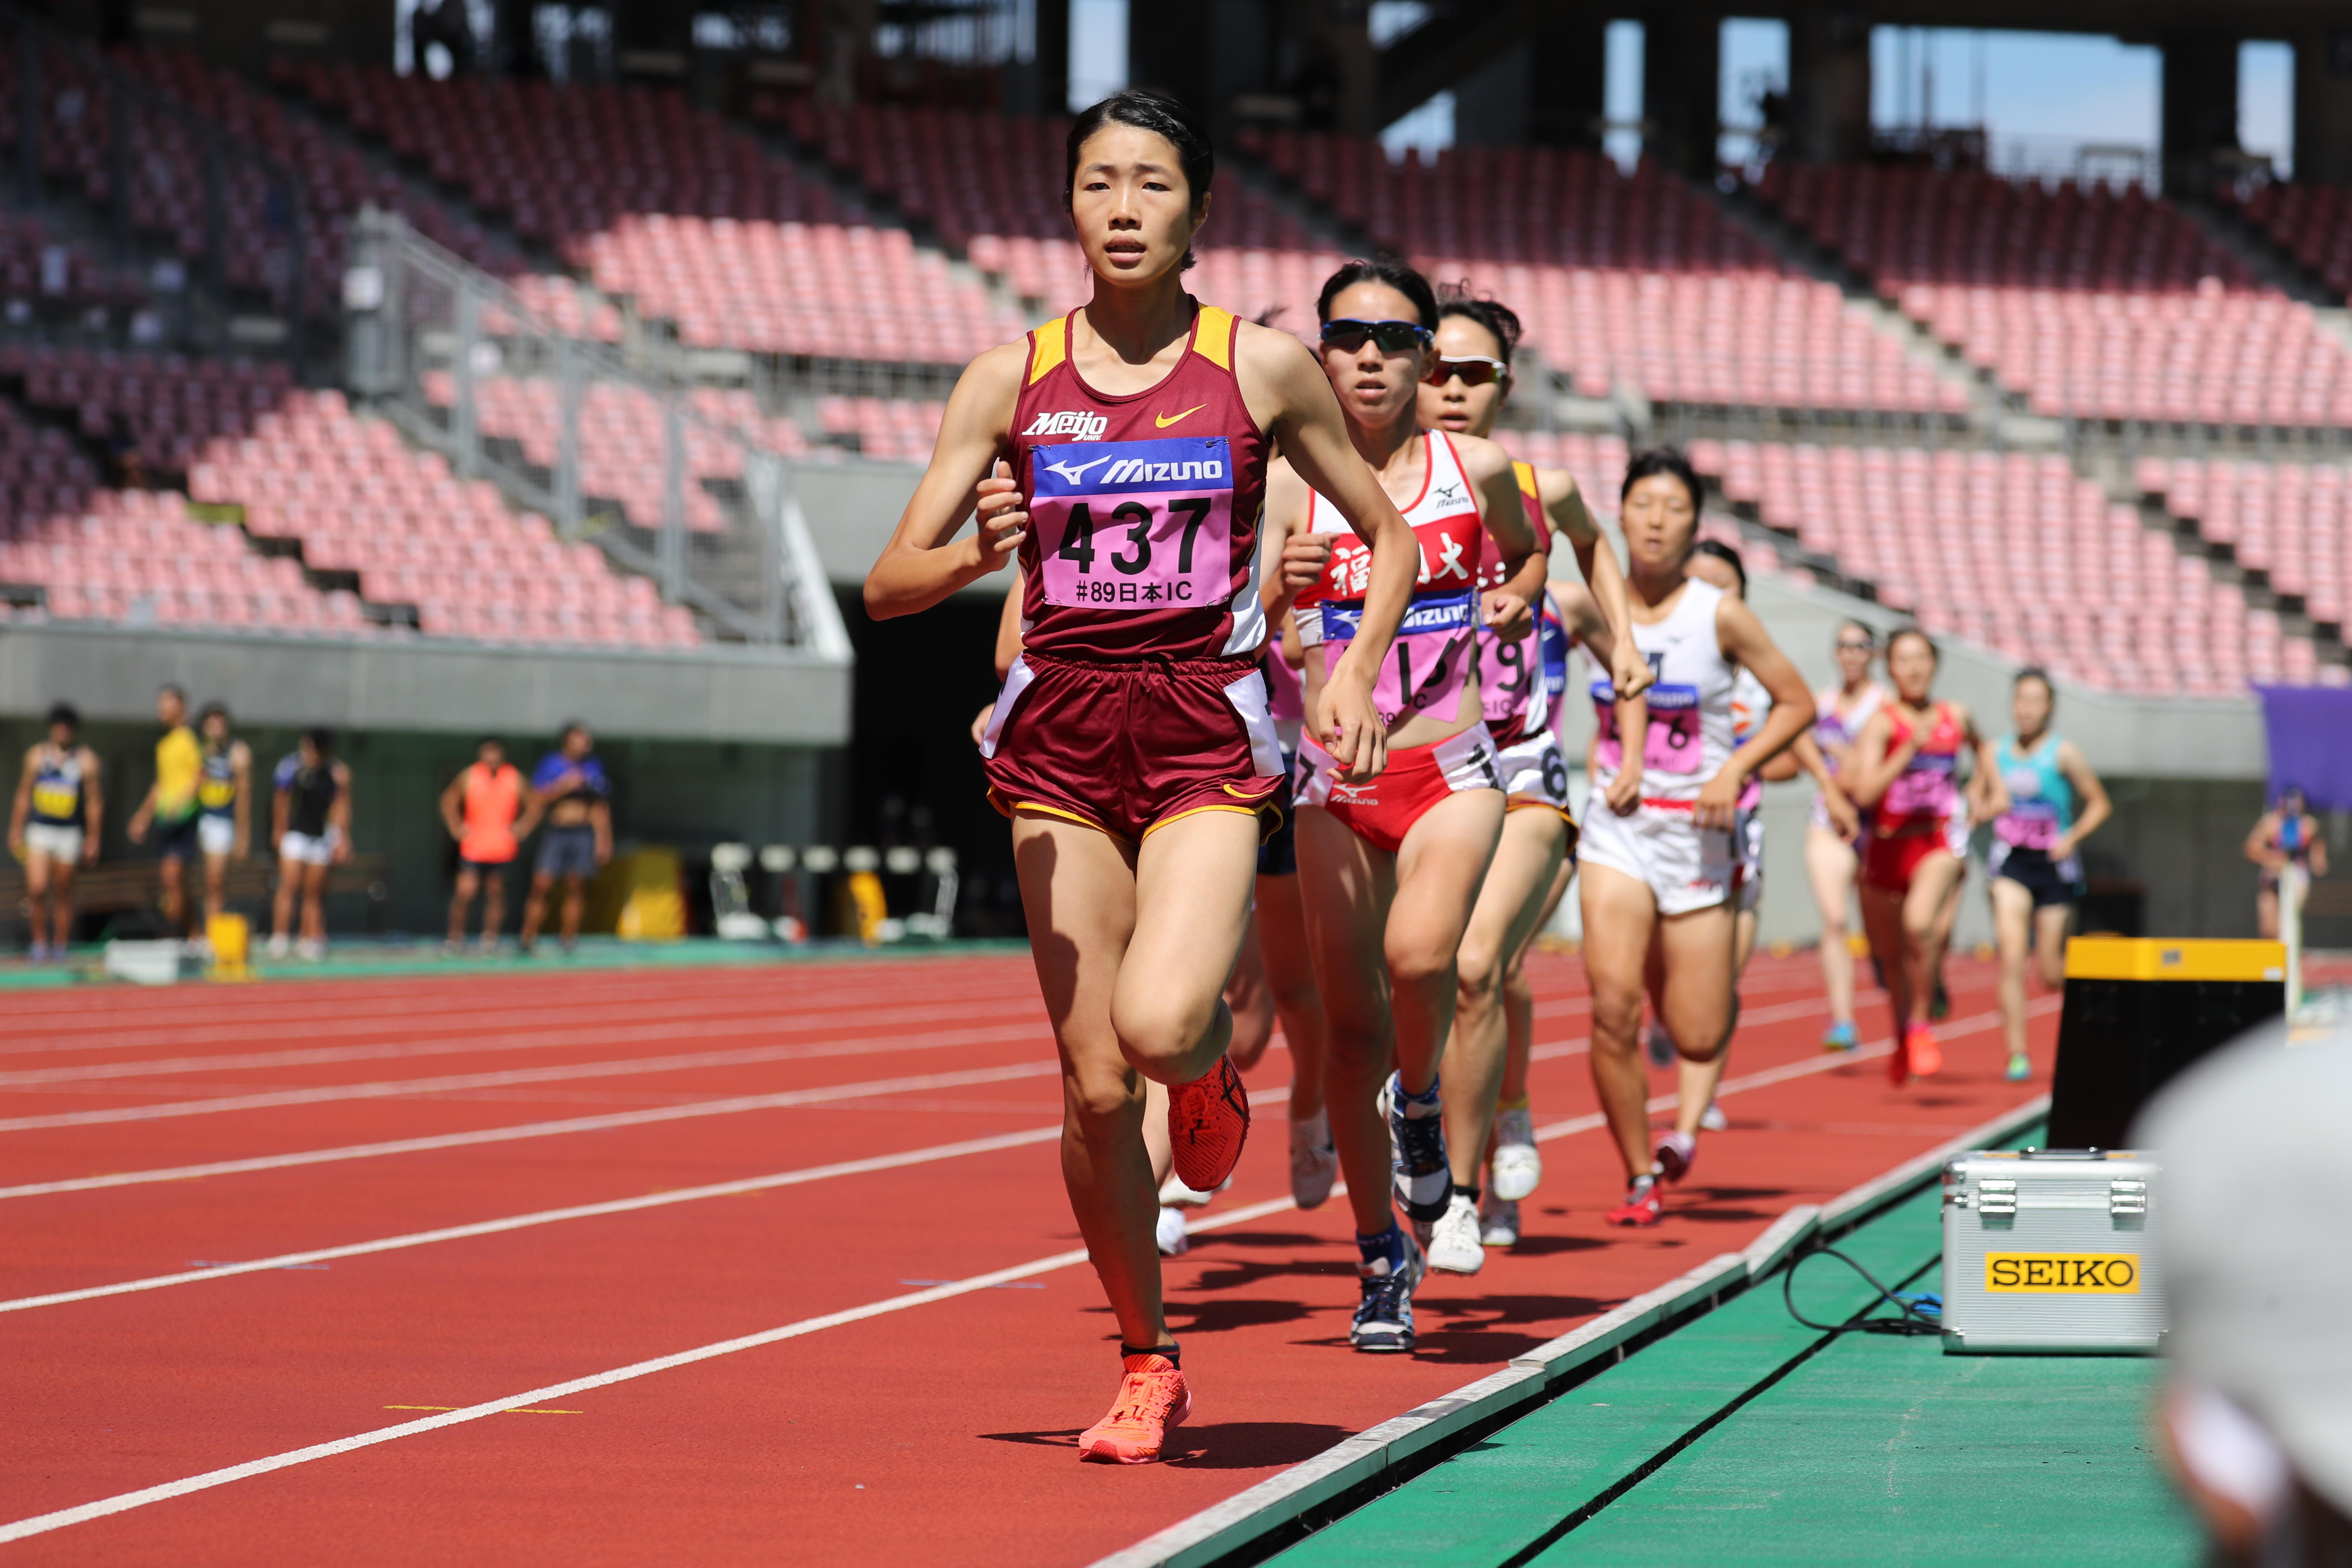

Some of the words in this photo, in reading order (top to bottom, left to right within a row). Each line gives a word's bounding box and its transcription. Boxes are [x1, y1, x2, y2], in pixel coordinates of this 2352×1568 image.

[1021, 411, 1108, 441] Meijo
[1059, 498, 1211, 575] 437
[1330, 533, 1468, 597] 福大
[1076, 580, 1192, 603] #89日本IC
[1993, 1260, 2134, 1287] SEIKO
